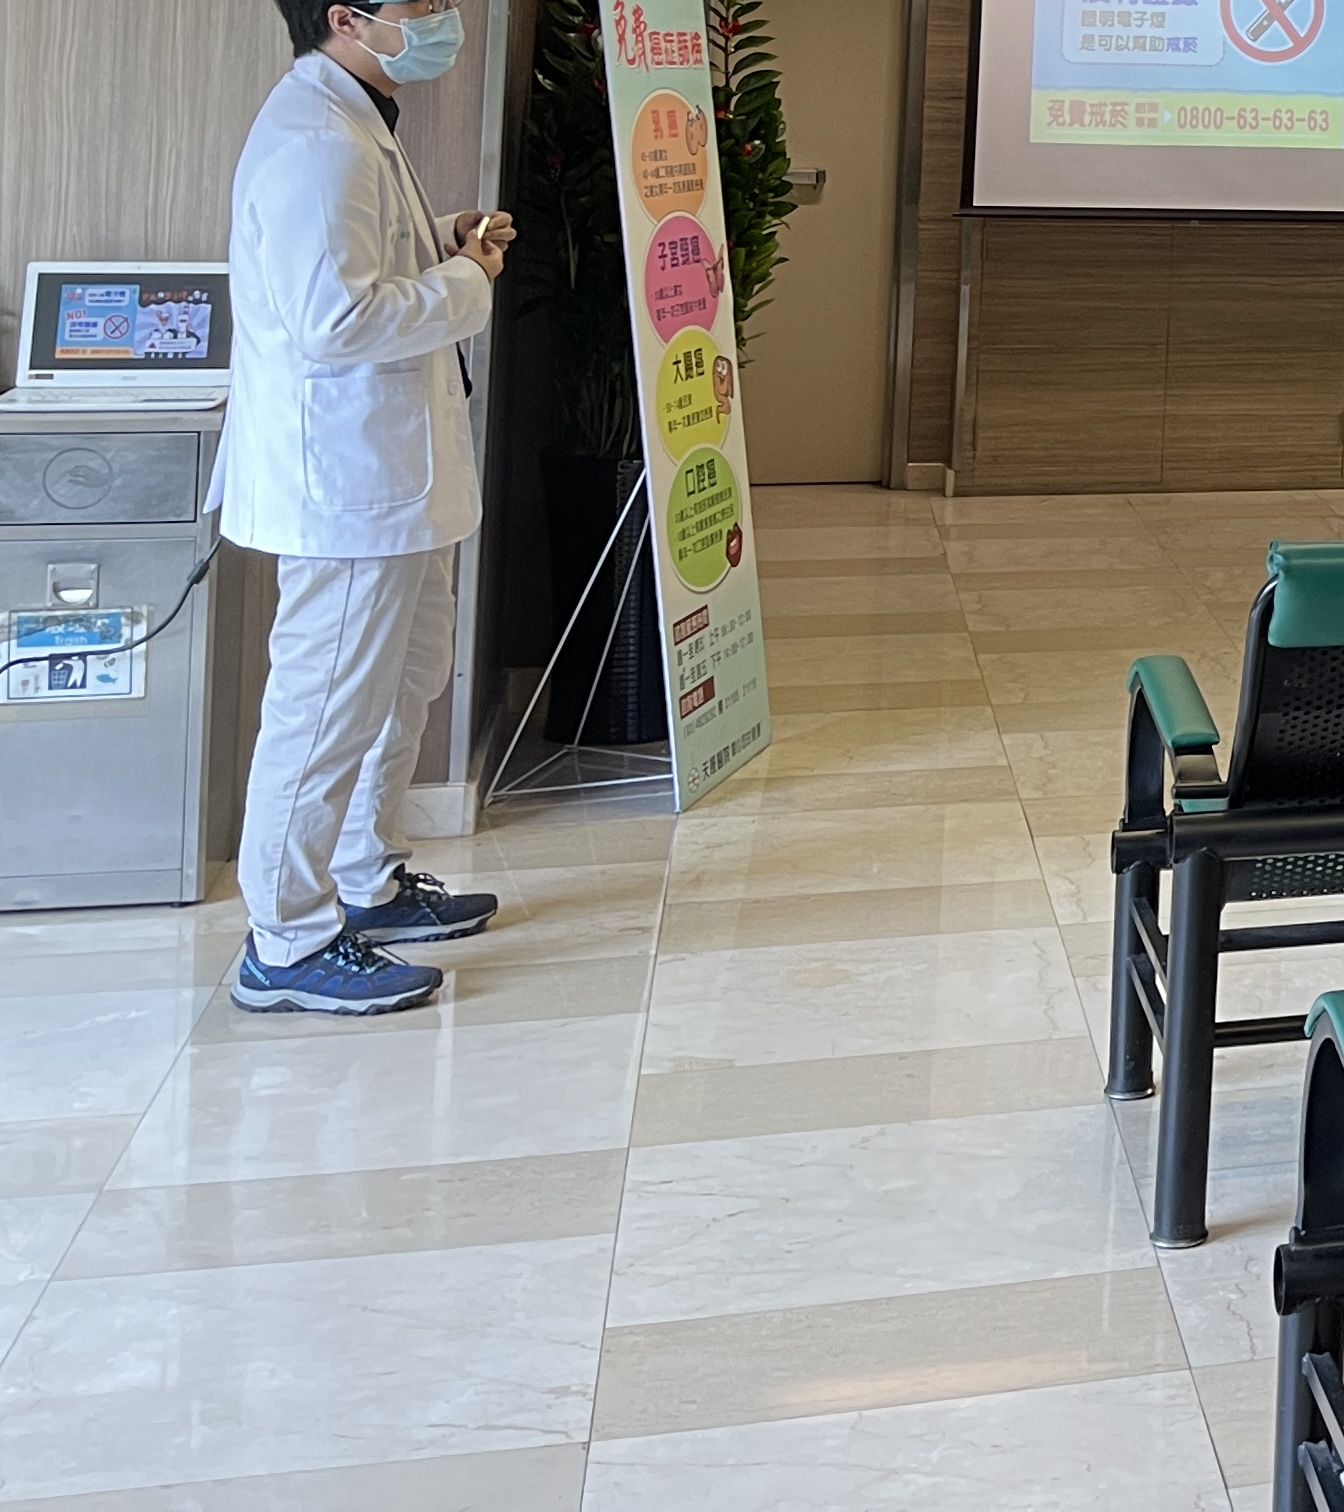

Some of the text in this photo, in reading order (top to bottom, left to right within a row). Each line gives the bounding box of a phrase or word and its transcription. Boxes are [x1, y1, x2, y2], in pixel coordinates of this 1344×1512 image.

[1045, 98, 1130, 130] 免費戒菸
[1176, 105, 1331, 133] 0800-63-63-63
